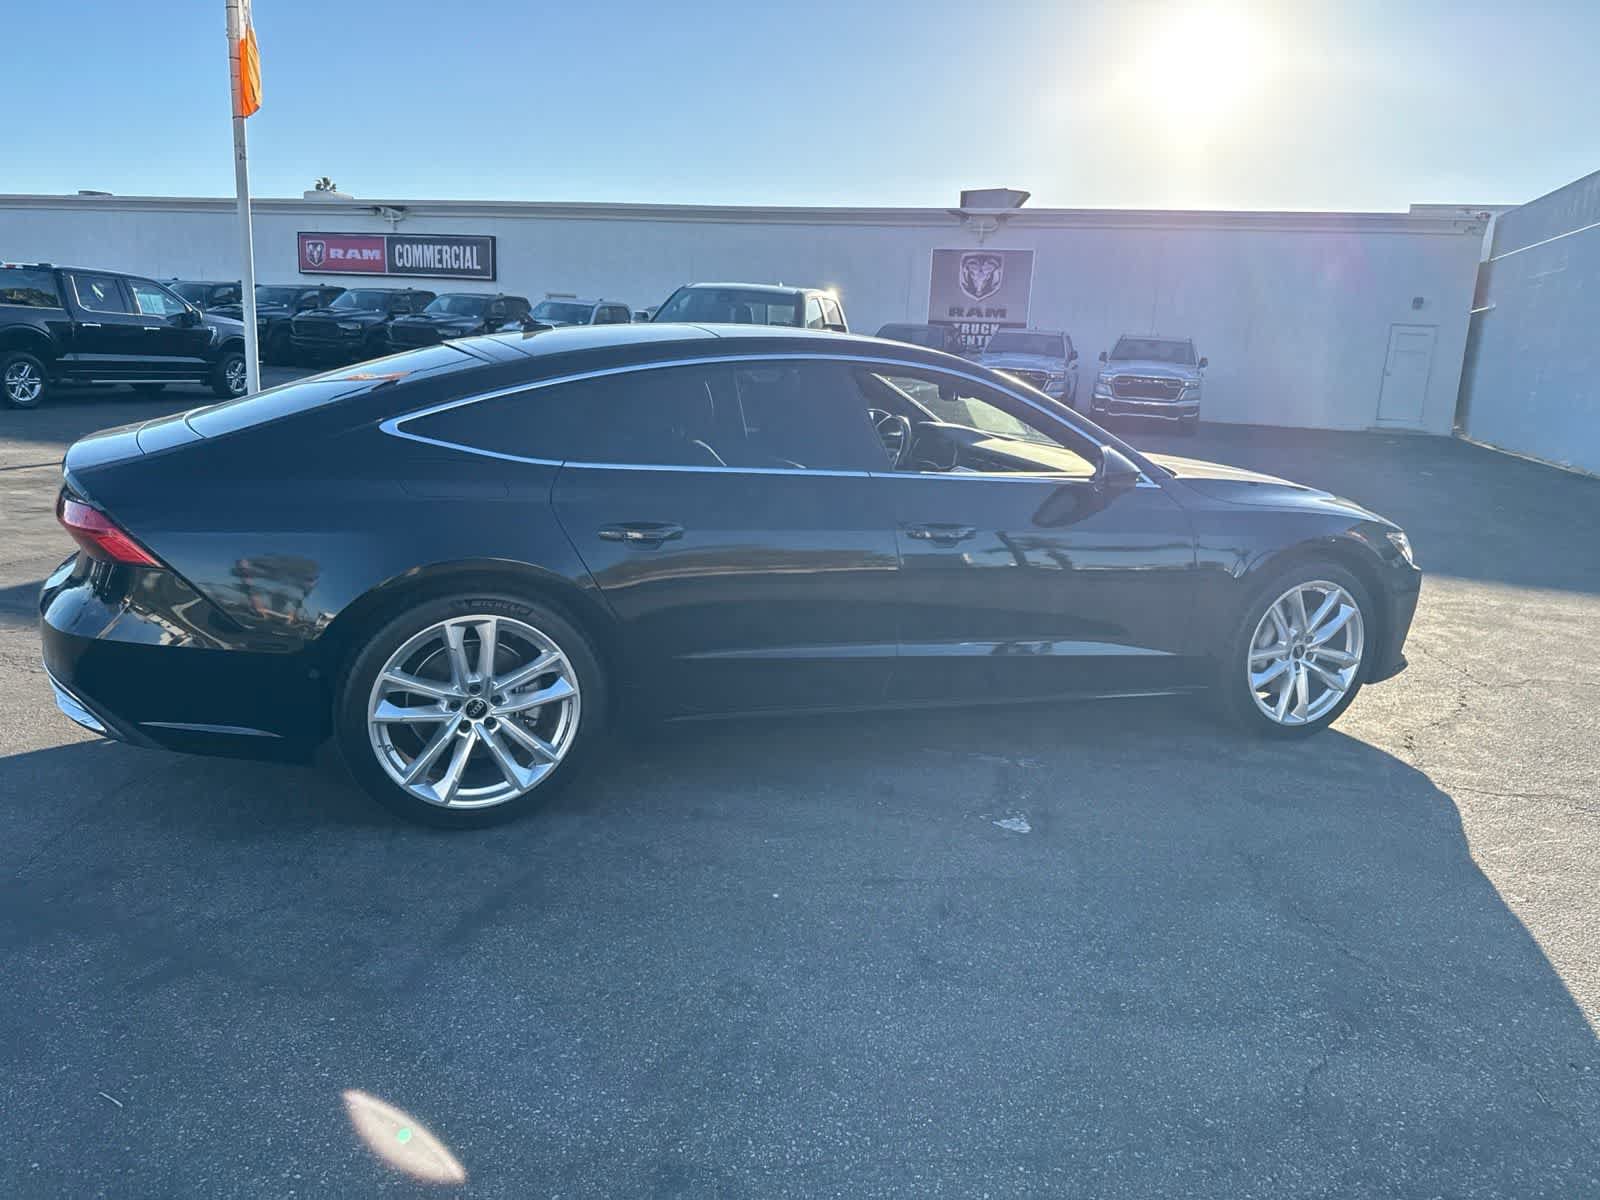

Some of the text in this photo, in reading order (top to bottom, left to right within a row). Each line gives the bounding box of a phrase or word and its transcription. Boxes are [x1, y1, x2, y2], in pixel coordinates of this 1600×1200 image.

[329, 248, 382, 261] RAM
[394, 244, 481, 270] COMMERCIAL
[948, 307, 1007, 319] RAM
